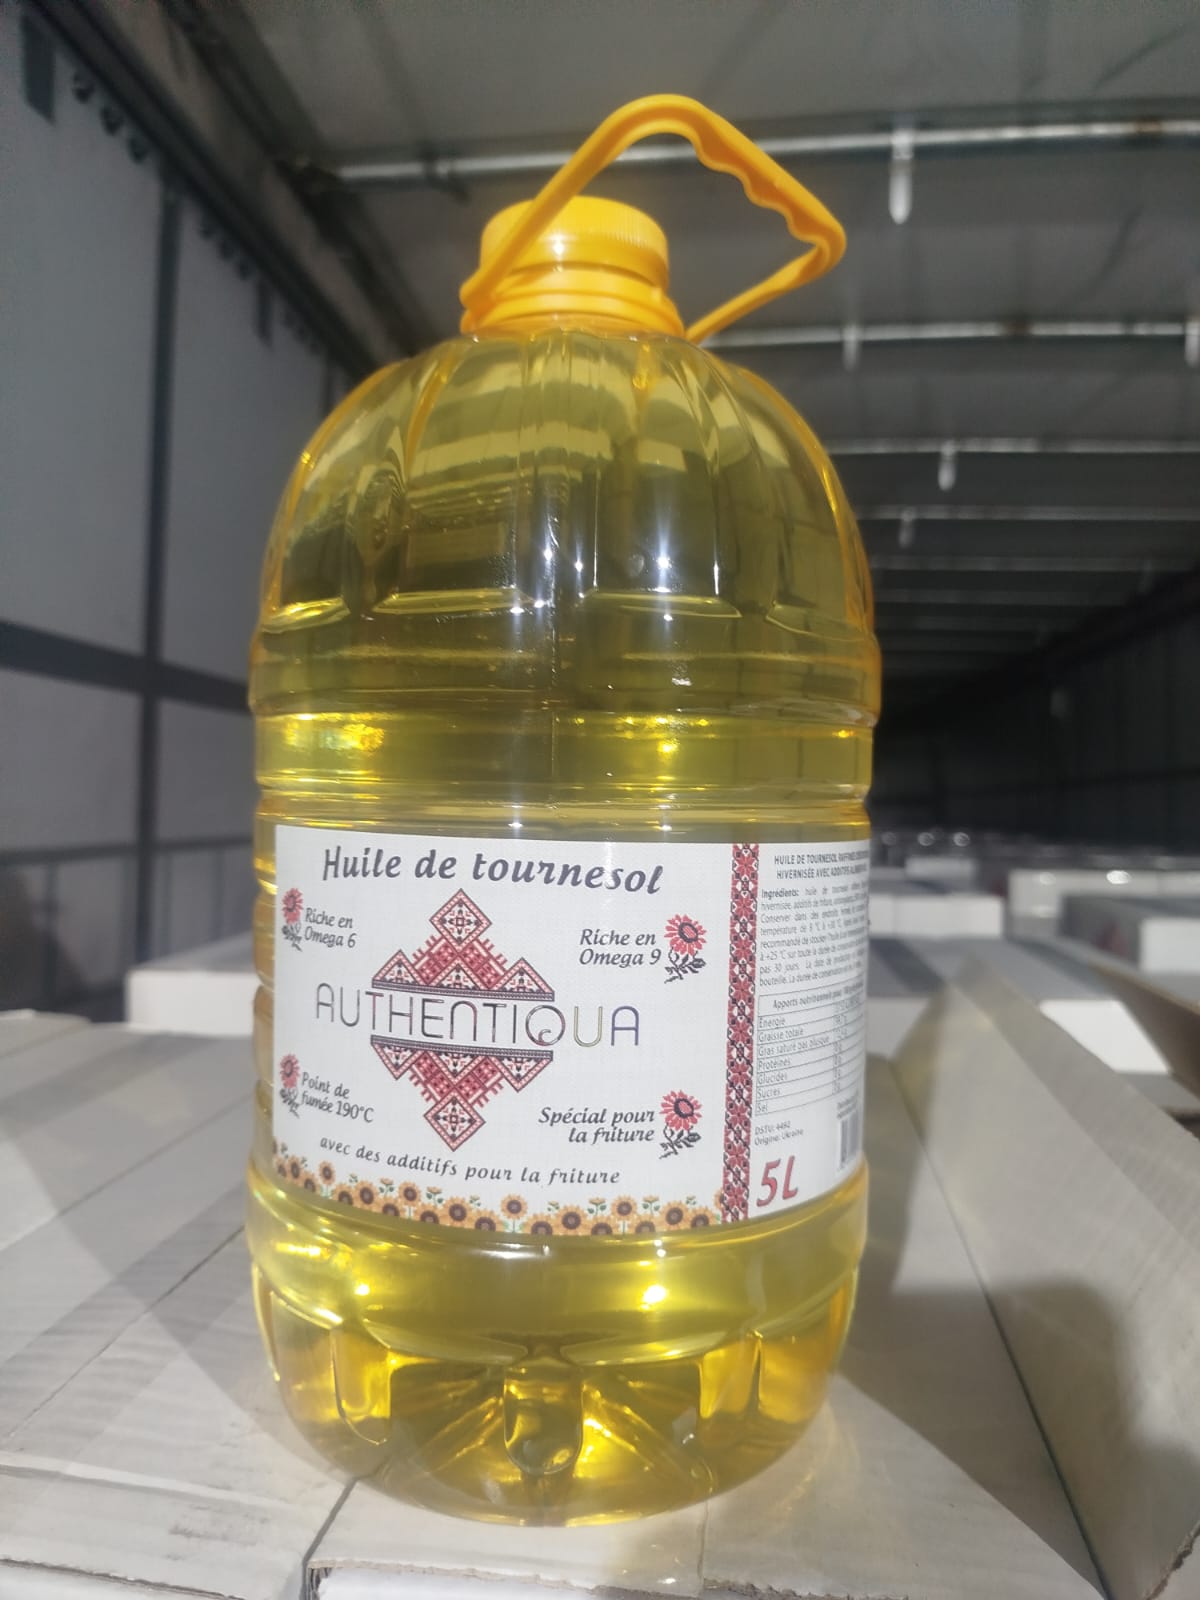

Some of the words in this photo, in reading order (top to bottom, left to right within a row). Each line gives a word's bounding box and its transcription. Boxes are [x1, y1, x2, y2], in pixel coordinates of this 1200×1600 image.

[323, 845, 401, 881] Huile
[415, 849, 457, 879] de
[472, 853, 664, 895] tournesol
[775, 855, 794, 864] HUILE
[797, 854, 805, 864] DE
[777, 868, 814, 879] HIVERNISÉE
[816, 868, 829, 878] AVEC
[305, 907, 335, 927] Riche
[337, 916, 354, 929] en
[304, 926, 344, 948] Omega
[347, 932, 357, 948] 6
[579, 929, 631, 946] Riche
[635, 934, 657, 946] en
[578, 948, 642, 968] Omega
[649, 948, 662, 966] 9
[315, 983, 640, 1047] AUTHENTIQUA
[302, 1072, 331, 1094] Point
[334, 1083, 351, 1099] de
[301, 1091, 333, 1113] fumée
[336, 1101, 374, 1123] 190°C
[538, 1107, 607, 1127] Spécial
[610, 1109, 655, 1127] pour
[568, 1128, 588, 1143] la
[592, 1127, 655, 1145] friture
[320, 1136, 351, 1155] avec
[355, 1145, 381, 1163] des
[387, 1153, 457, 1177] additifs
[464, 1165, 513, 1181] pour
[520, 1167, 541, 1183] la
[548, 1168, 621, 1185] friture
[757, 1155, 798, 1207] 5L
